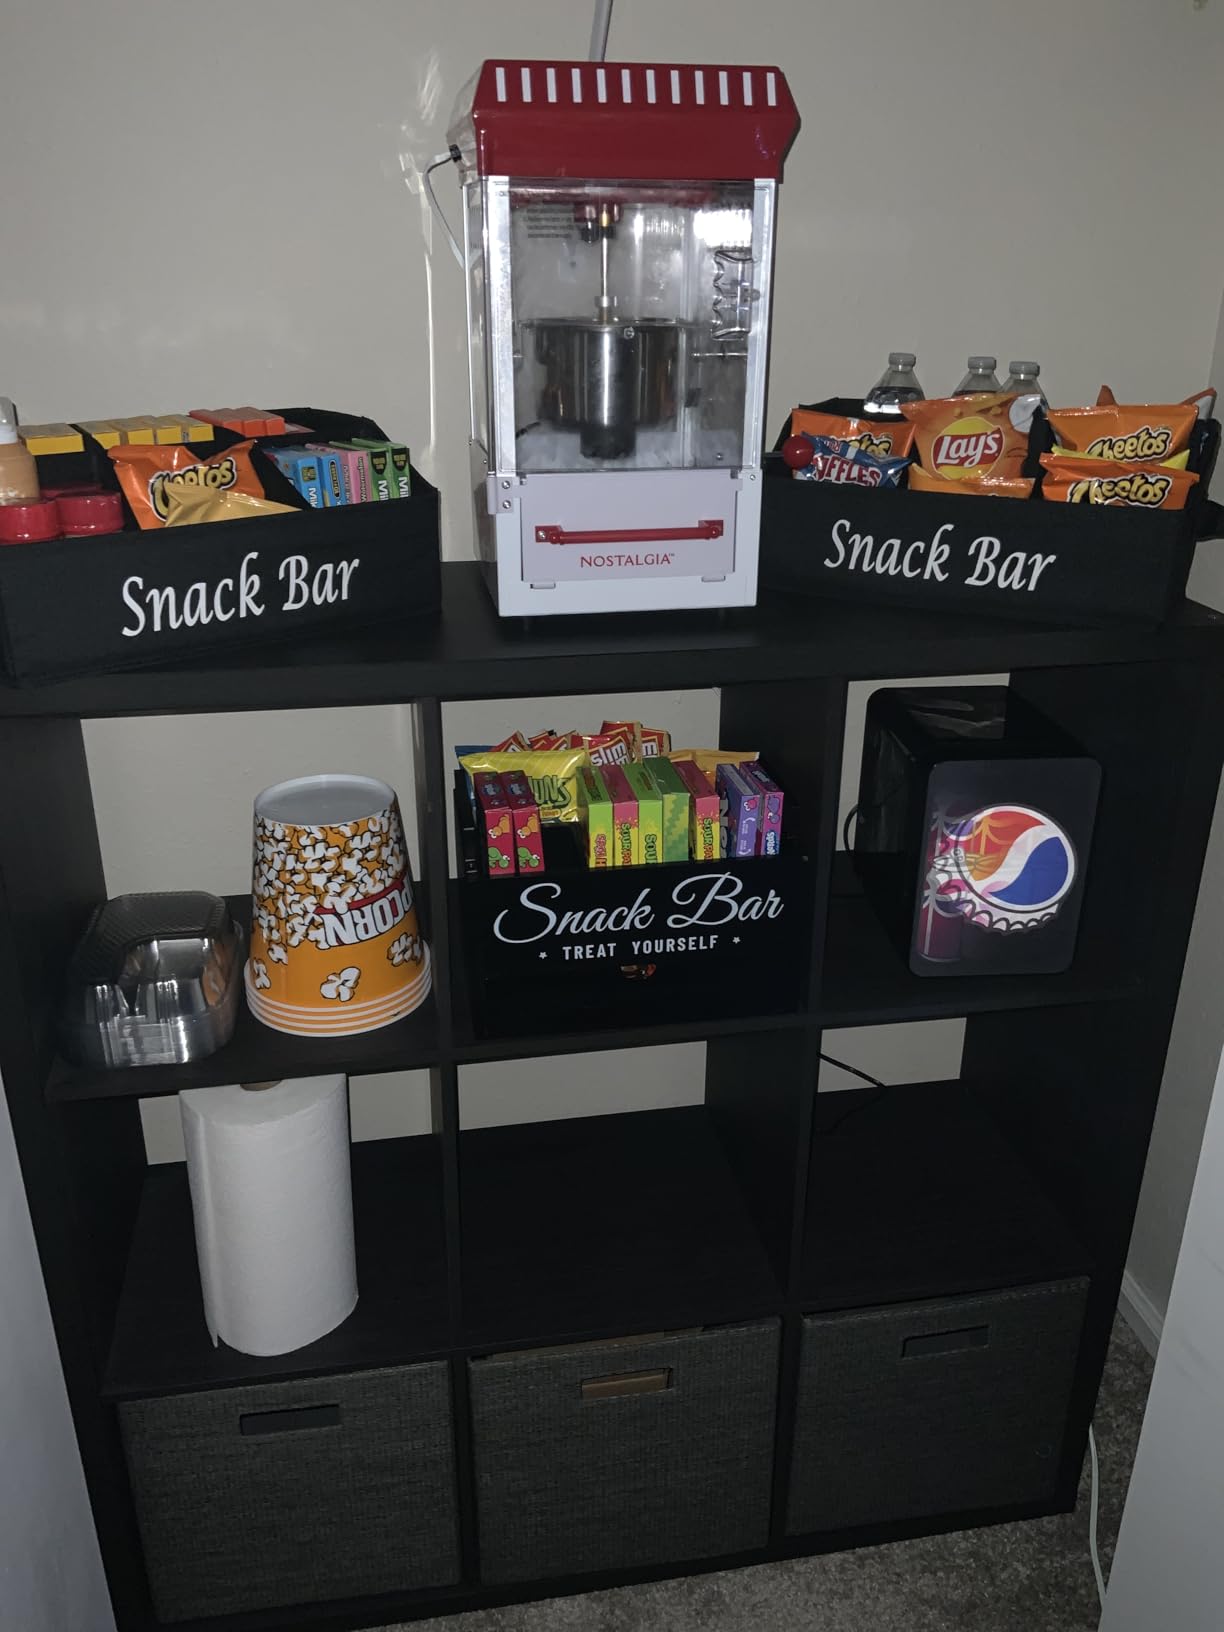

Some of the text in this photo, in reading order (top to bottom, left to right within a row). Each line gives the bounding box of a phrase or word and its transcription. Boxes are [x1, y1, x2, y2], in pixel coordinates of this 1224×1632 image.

[812, 453, 883, 487] UFFLES
[824, 519, 1057, 591] Snack Bar
[122, 551, 360, 637] Snack Bar
[493, 871, 785, 944] Snack Bar
[562, 935, 719, 961] TREAT YOURSELF
